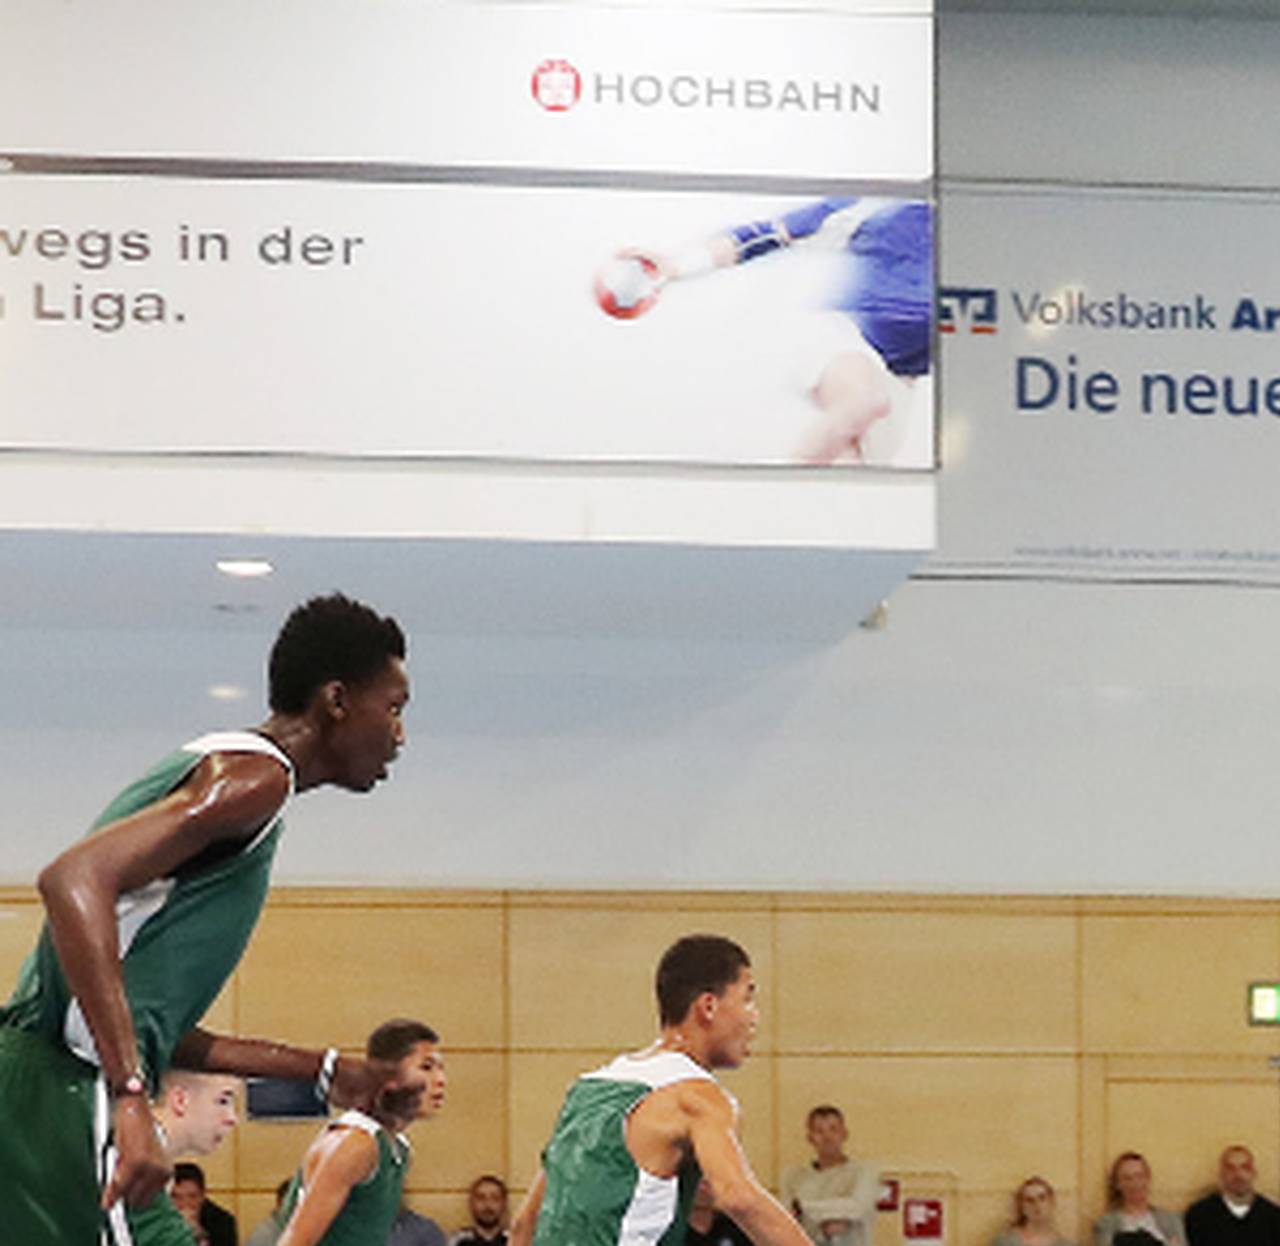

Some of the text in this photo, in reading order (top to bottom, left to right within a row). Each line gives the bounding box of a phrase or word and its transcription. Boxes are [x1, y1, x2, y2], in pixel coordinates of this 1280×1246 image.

[594, 74, 880, 112] HOCHBAHN
[179, 225, 229, 261] in
[258, 226, 364, 266] der
[33, 283, 186, 333] Liga.
[1012, 290, 1218, 330] Volksbank
[1016, 354, 1119, 413] Die
